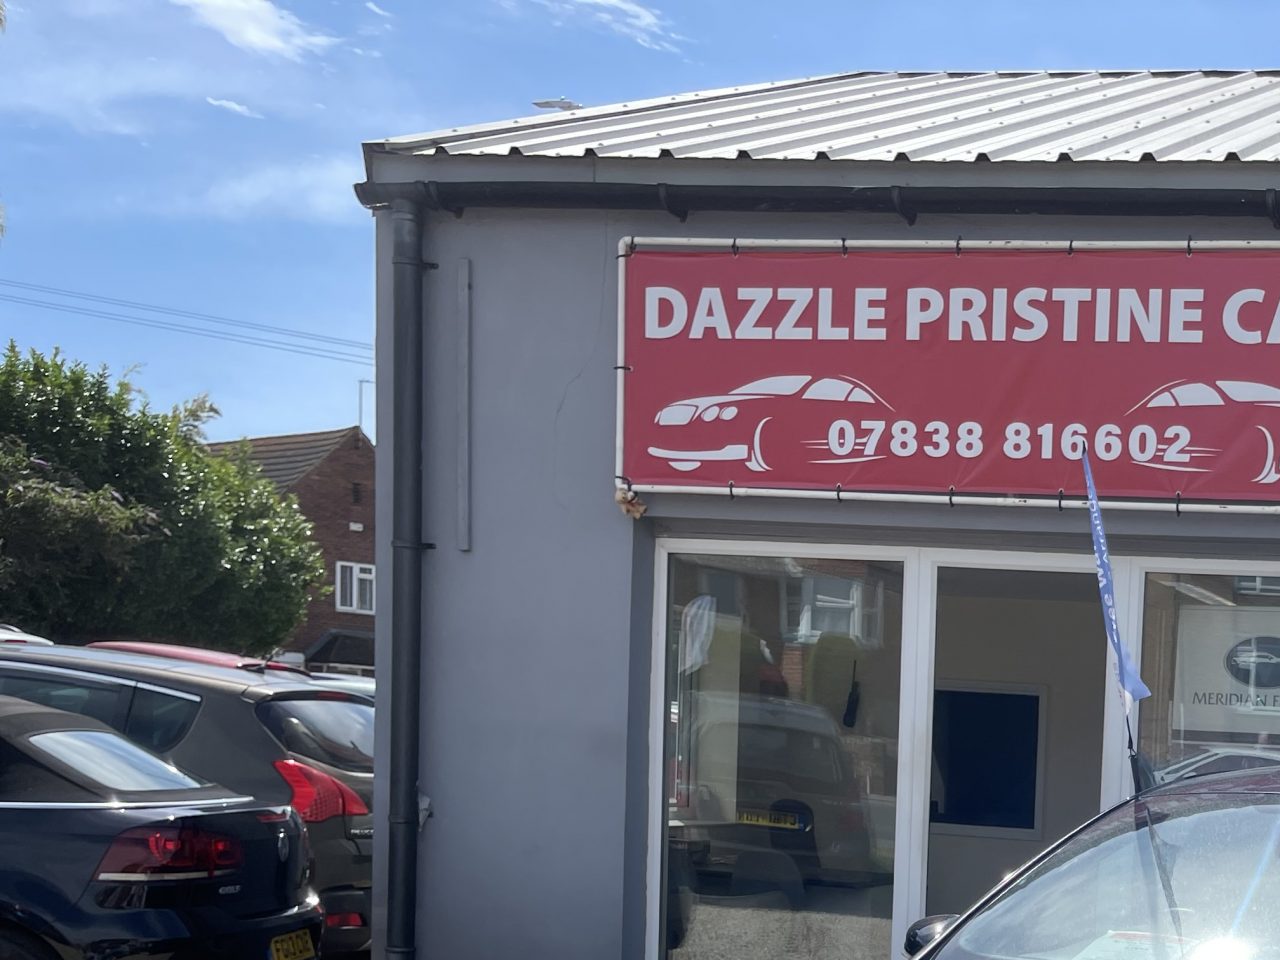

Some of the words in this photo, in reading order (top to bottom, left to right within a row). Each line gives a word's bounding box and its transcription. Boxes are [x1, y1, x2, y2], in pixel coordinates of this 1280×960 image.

[644, 286, 888, 341] DAZZLE
[905, 287, 1205, 344] PRISTINE
[827, 419, 984, 458] 07838
[1003, 421, 1192, 463] 816602
[1191, 692, 1268, 707] MERIDIAN
